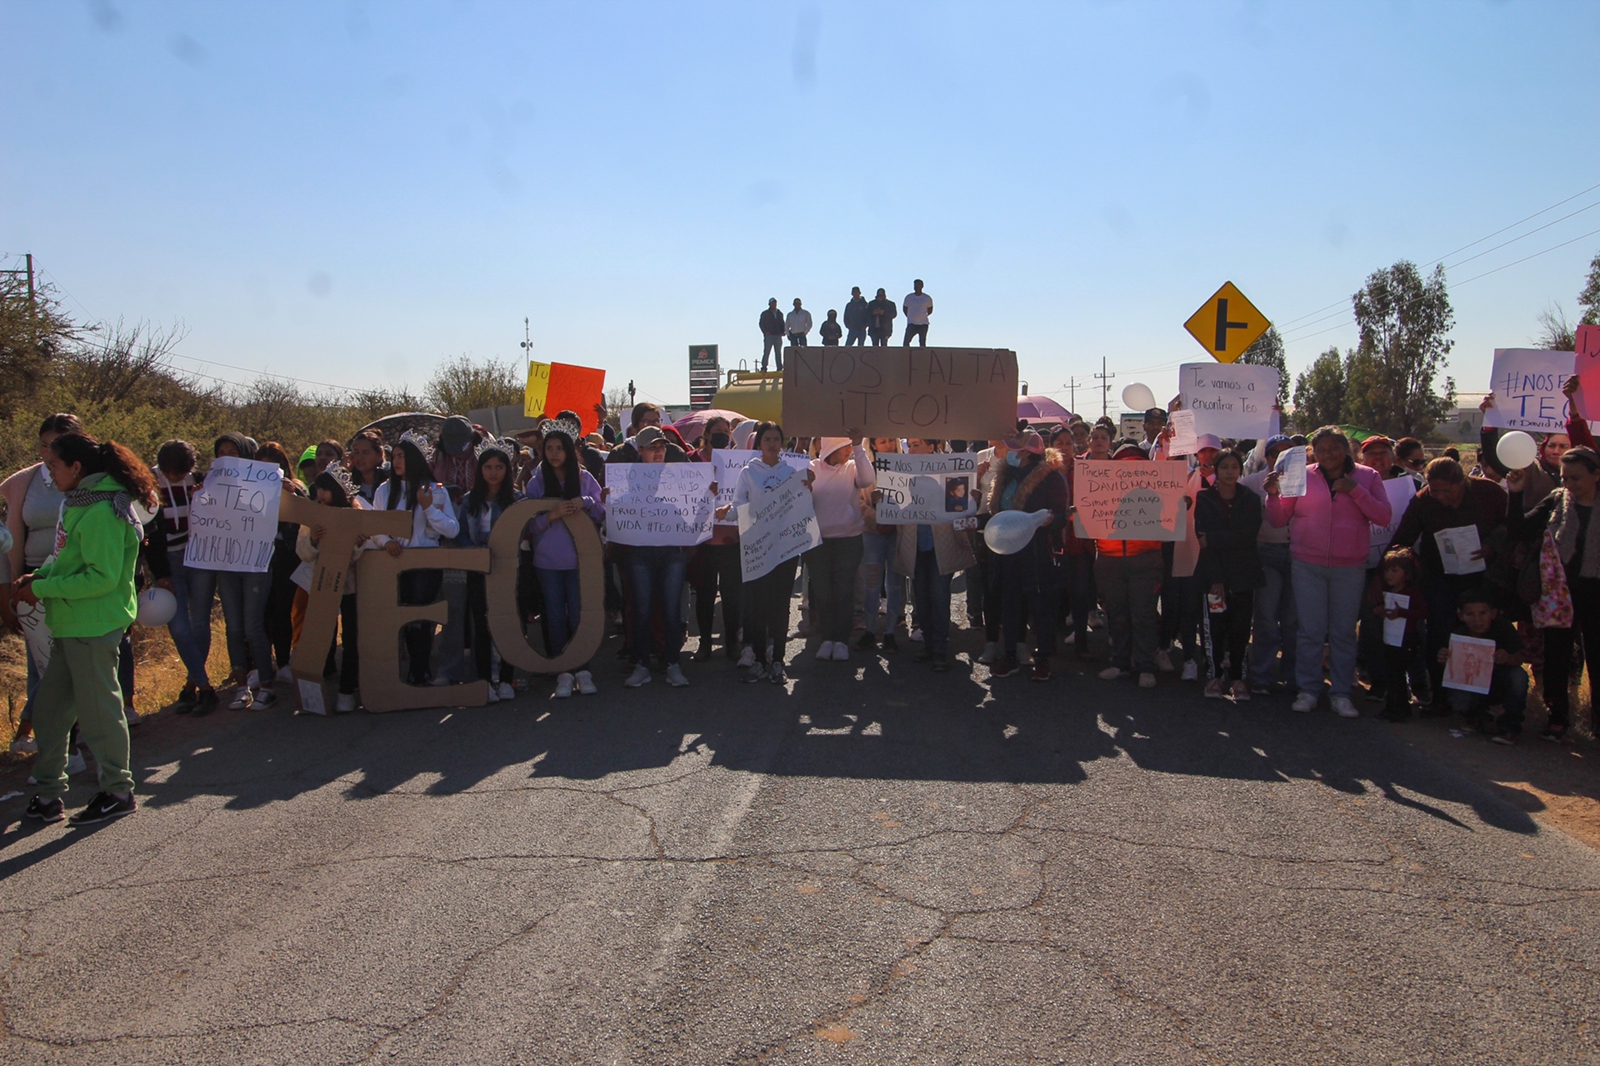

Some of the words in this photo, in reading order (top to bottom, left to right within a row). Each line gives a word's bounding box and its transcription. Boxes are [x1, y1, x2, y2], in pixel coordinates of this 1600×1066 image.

[793, 349, 882, 388] NOS
[908, 349, 1006, 386] FALTA
[1190, 367, 1206, 388] Te
[1210, 380, 1241, 390] vamos
[1248, 383, 1255, 392] a
[557, 392, 584, 407] TEO
[1192, 396, 1234, 412] encontrar
[1239, 397, 1258, 413] Teo
[838, 389, 949, 427] ¡TEO!
[725, 459, 748, 469] Just
[920, 460, 946, 472] FALTA
[948, 458, 974, 470] TEO
[1078, 462, 1112, 478] PINCHE
[1116, 468, 1158, 479] GOBIERNO
[242, 463, 279, 483] 100
[606, 465, 636, 482] ESTO
[644, 471, 656, 479] NO
[659, 470, 674, 479] ES
[680, 470, 704, 480] VIDA
[609, 484, 644, 493] PENSAR
[660, 482, 672, 490] TU
[888, 476, 895, 486] Y
[898, 476, 917, 488] SIN
[200, 492, 216, 506] Sin
[217, 483, 266, 514] TEO
[630, 496, 642, 504] YA
[680, 494, 710, 504] TIENE
[876, 486, 904, 505] TEO
[912, 494, 924, 505] NO
[1080, 496, 1110, 508] SIRVE
[1138, 496, 1160, 504] ALGO
[640, 507, 668, 518] ESTO
[674, 508, 688, 516] NO
[692, 506, 710, 516] ES
[880, 508, 900, 519] HAY
[902, 510, 936, 520] CLASES
[1092, 508, 1132, 519] APARECE
[1138, 508, 1146, 516] A
[190, 510, 232, 531] Somos
[241, 516, 254, 532] 99
[647, 522, 672, 533] #TEO
[780, 528, 792, 540] NOS
[792, 516, 812, 532] FALTA
[1096, 518, 1128, 530] TEO
